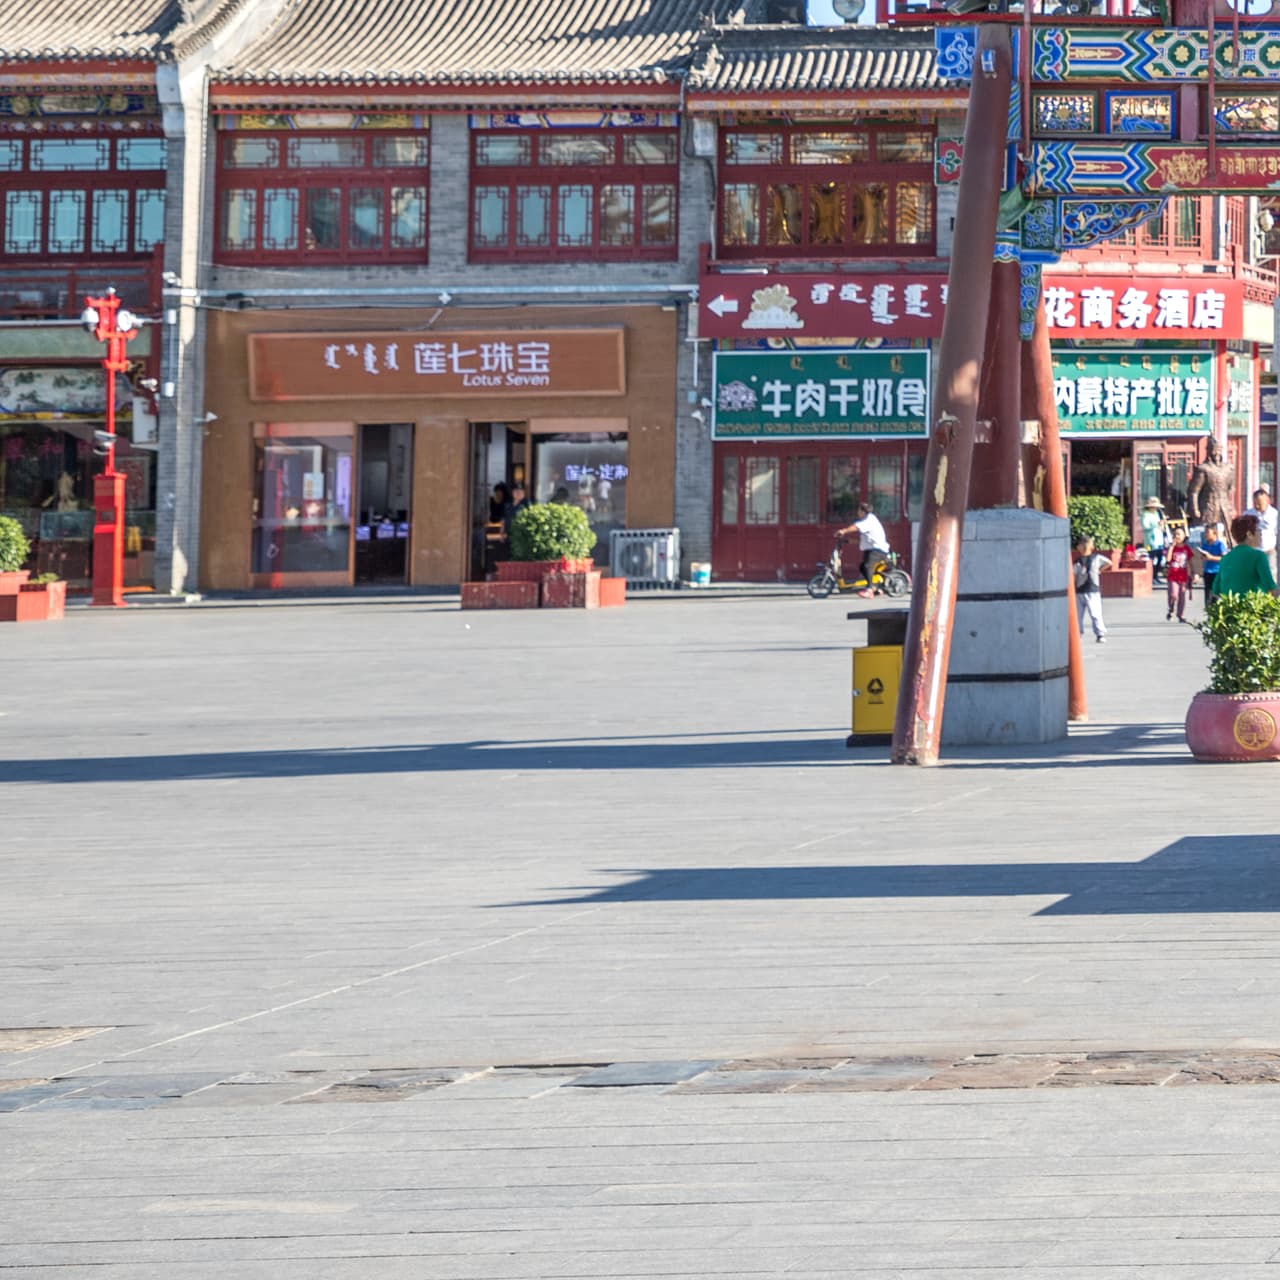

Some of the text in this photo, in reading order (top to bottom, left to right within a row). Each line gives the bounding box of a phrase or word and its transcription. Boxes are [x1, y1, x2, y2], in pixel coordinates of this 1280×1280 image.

[1043, 287, 1226, 329] 花商务酒店
[413, 342, 550, 374] 莲七珠宝
[463, 373, 550, 387] Lotus Seven
[761, 378, 926, 418] 牛肉干奶食
[1053, 376, 1210, 416] 内蒙特产批发
